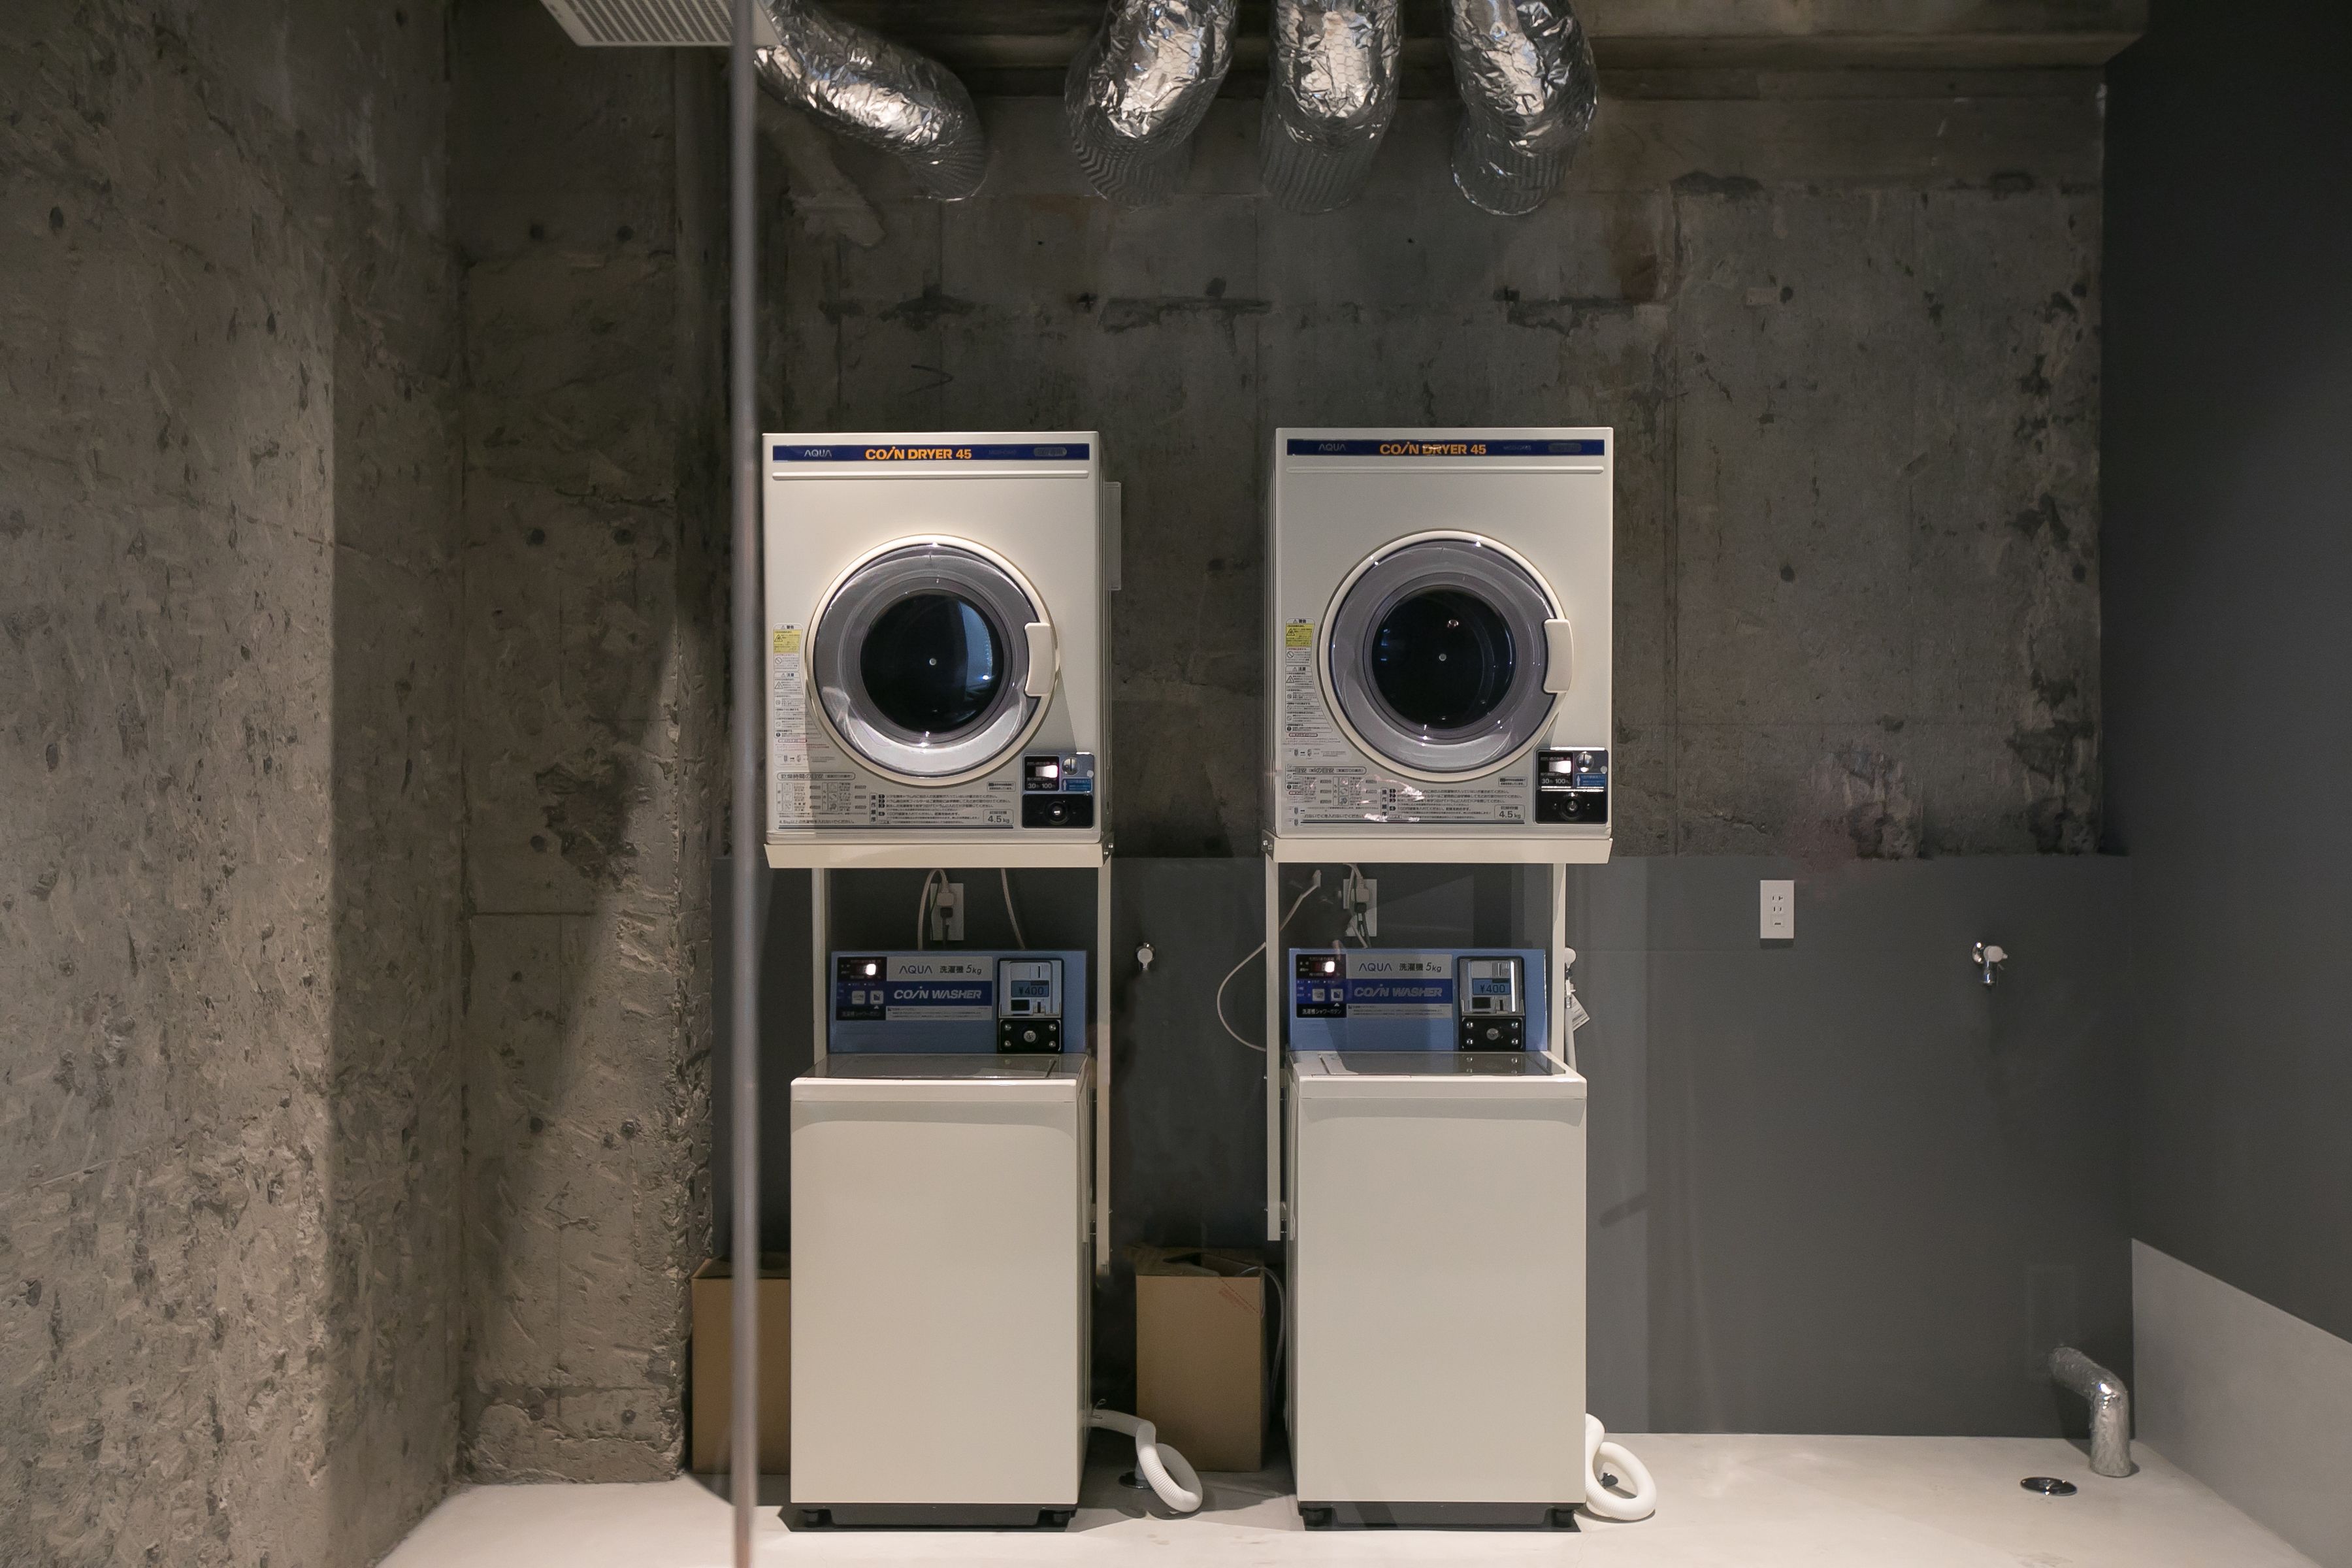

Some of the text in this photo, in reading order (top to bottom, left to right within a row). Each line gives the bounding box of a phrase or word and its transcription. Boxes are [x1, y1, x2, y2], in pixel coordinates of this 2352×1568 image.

[804, 449, 832, 457] AQUA
[908, 448, 953, 460] DRYER
[955, 448, 972, 459] 45
[1422, 444, 1467, 455] DRYER
[1470, 444, 1486, 455] 45
[899, 964, 982, 975] AQUA 洗濯機 5kg
[1358, 962, 1442, 973] AQUA 洗濯機 5kg
[1019, 987, 1045, 995] ¥400
[1392, 987, 1443, 998] WASHER
[1479, 984, 1505, 993] ¥400
[932, 989, 983, 1000] WASHER
